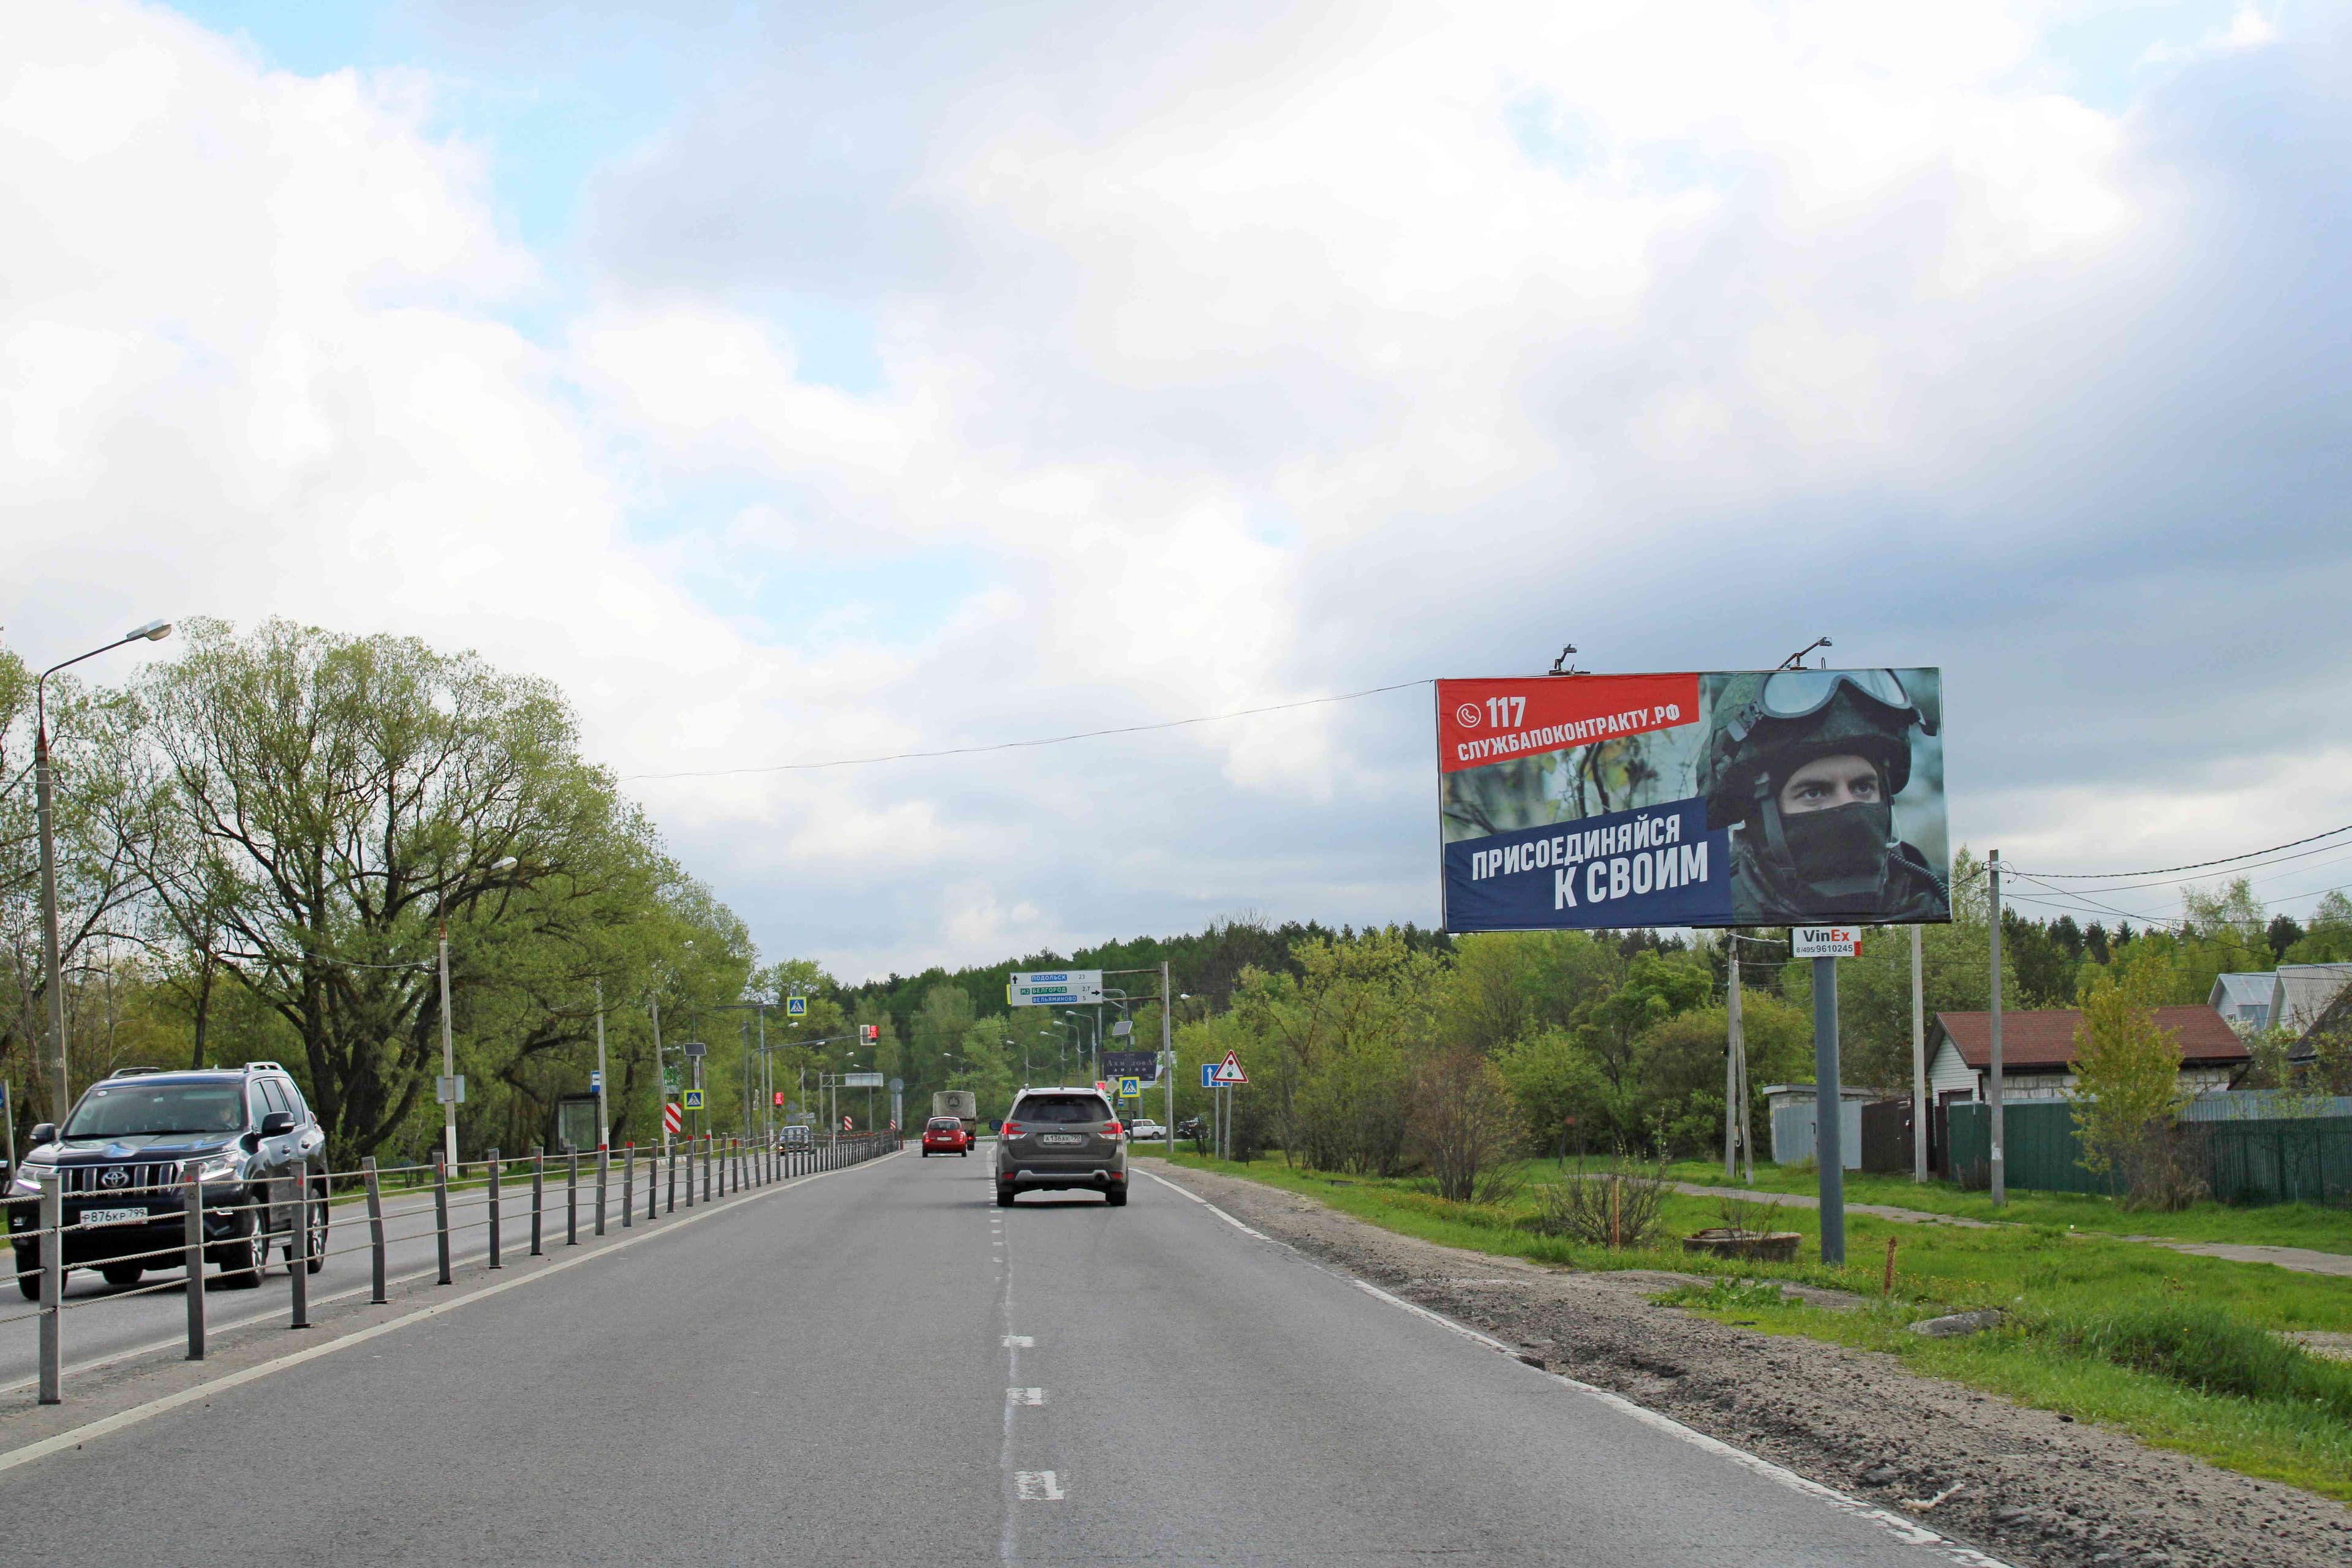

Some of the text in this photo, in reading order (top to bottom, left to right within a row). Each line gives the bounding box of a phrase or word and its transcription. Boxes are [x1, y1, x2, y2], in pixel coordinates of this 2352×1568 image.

[1457, 704, 1681, 761] СЛУЖБАПОКОНТРАКТУ.РФ
[1487, 696, 1526, 728] 117
[1472, 813, 1680, 881] ПРИСОЕДИНЯЙСЯ
[1555, 841, 1708, 910] К СВОИМ
[1803, 929, 1850, 942] VinEx
